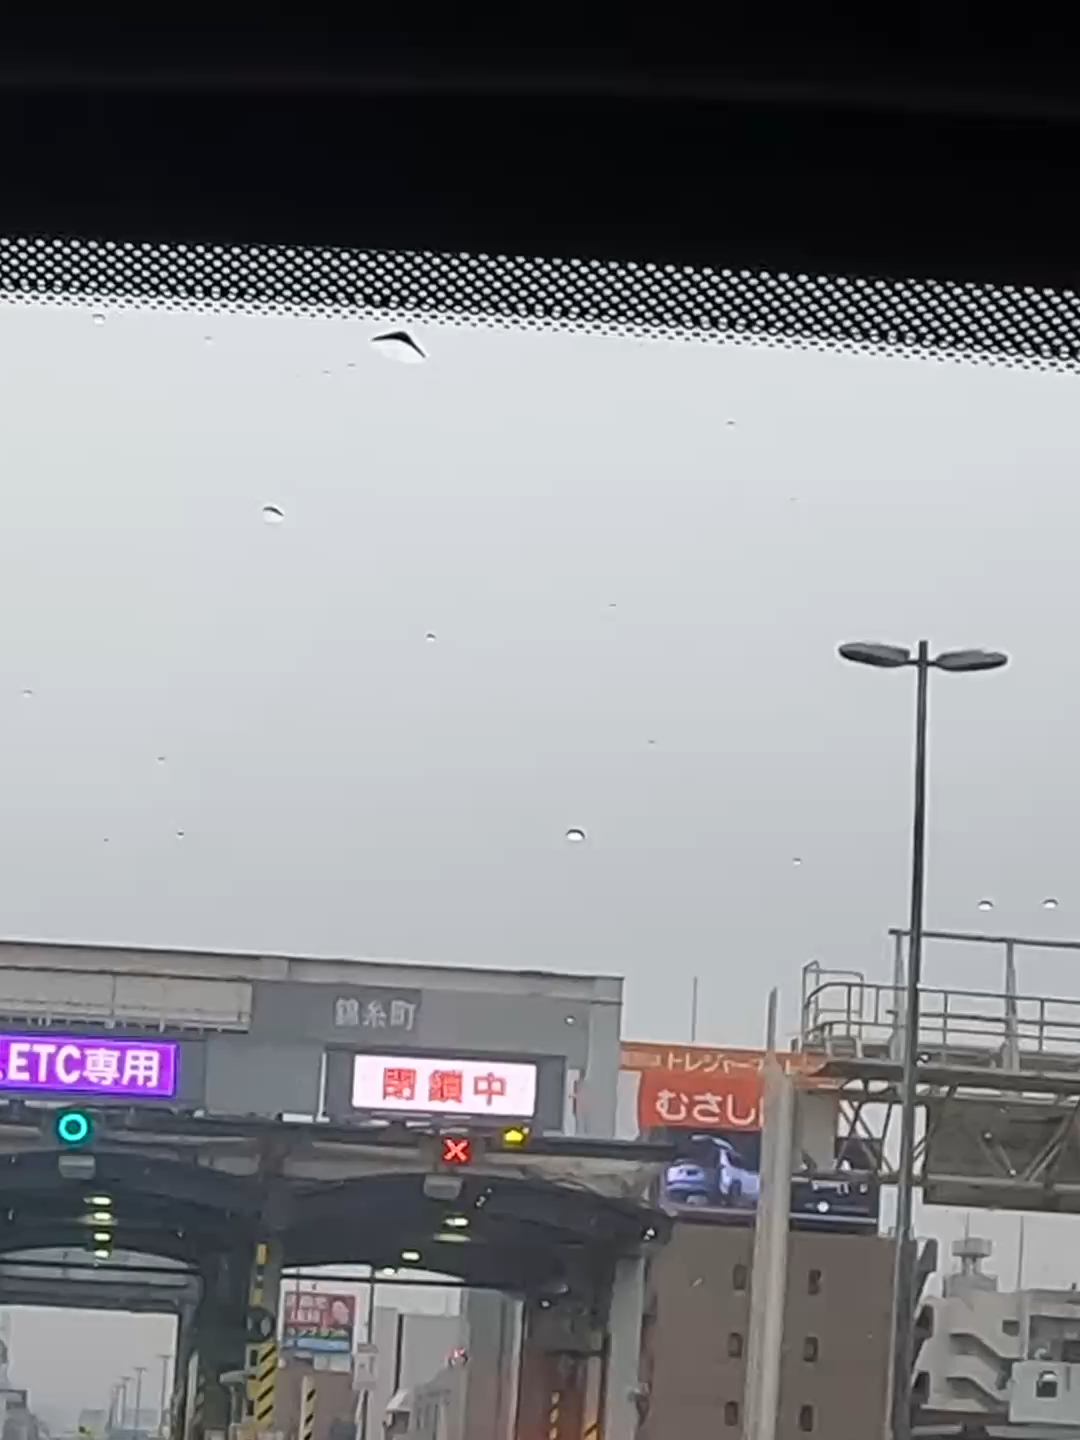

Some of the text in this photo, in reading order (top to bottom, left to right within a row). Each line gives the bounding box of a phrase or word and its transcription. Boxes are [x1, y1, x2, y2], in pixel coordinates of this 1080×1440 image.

[7, 1043, 160, 1088] ETC専用
[655, 1087, 765, 1128] むさし
